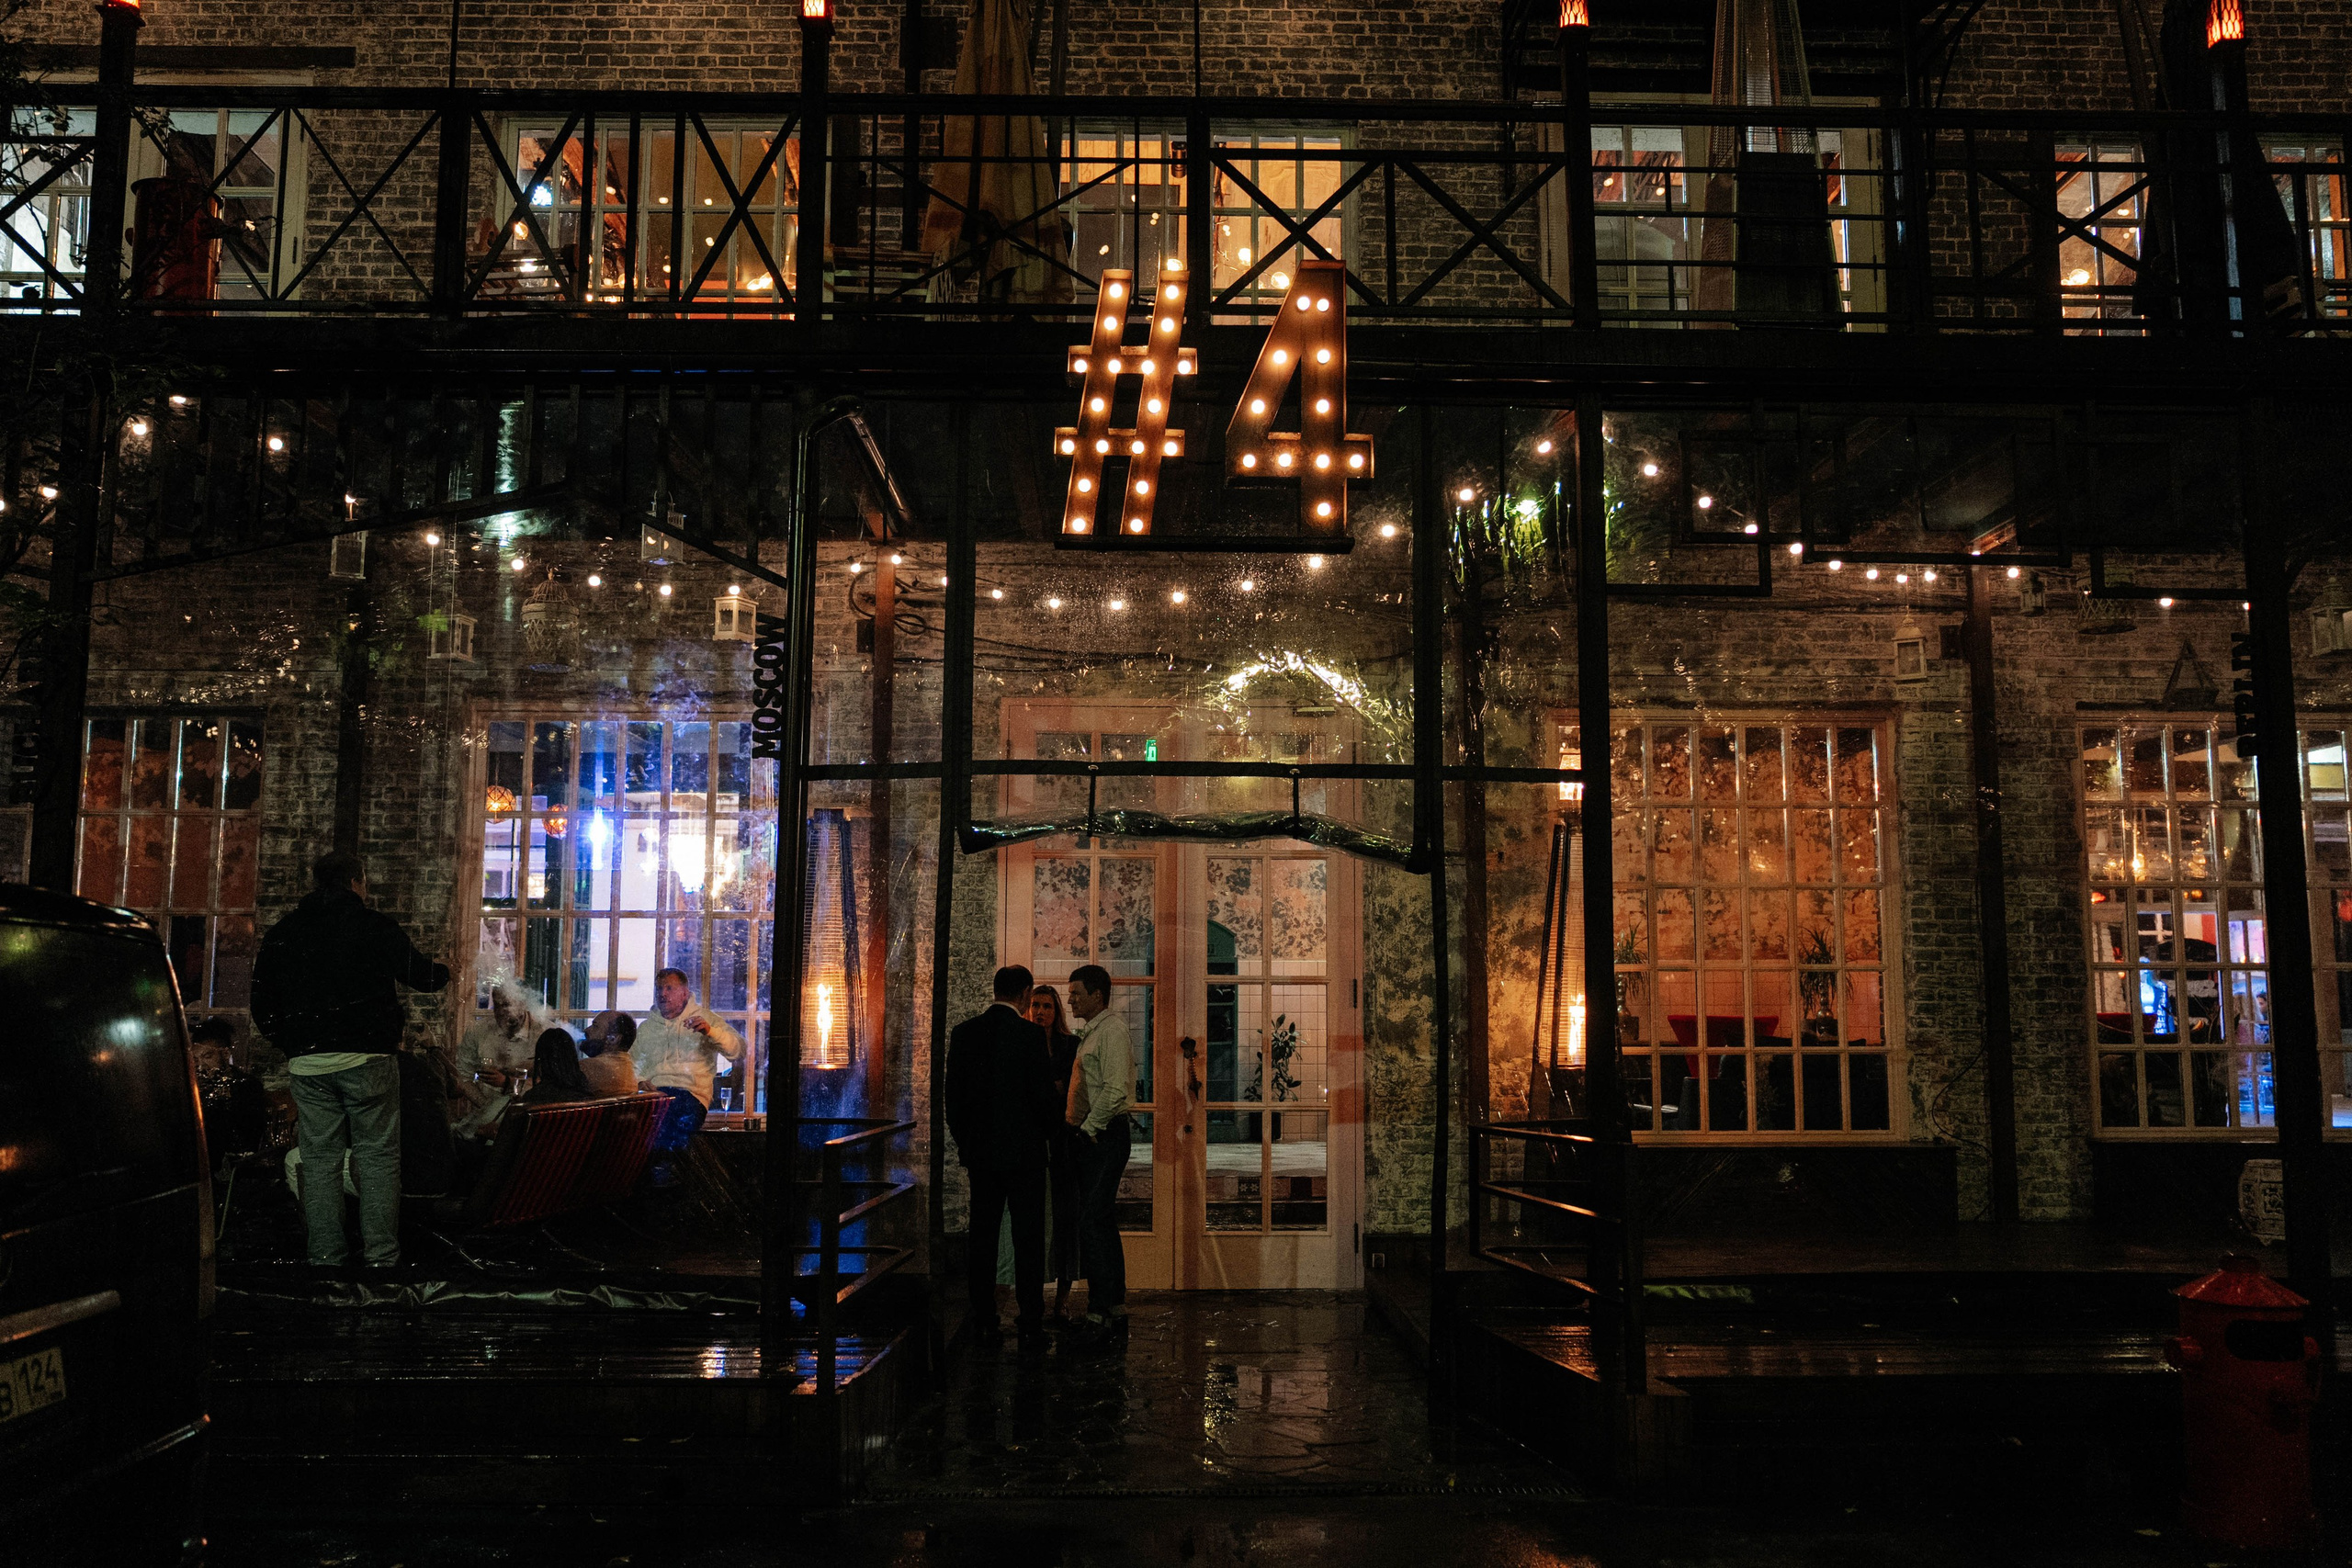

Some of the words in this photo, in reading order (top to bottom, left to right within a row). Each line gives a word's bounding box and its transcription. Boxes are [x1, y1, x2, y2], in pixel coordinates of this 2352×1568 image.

[1055, 260, 1374, 536] #4
[752, 612, 786, 761] MOSCOW
[19, 1353, 58, 1399] 124
